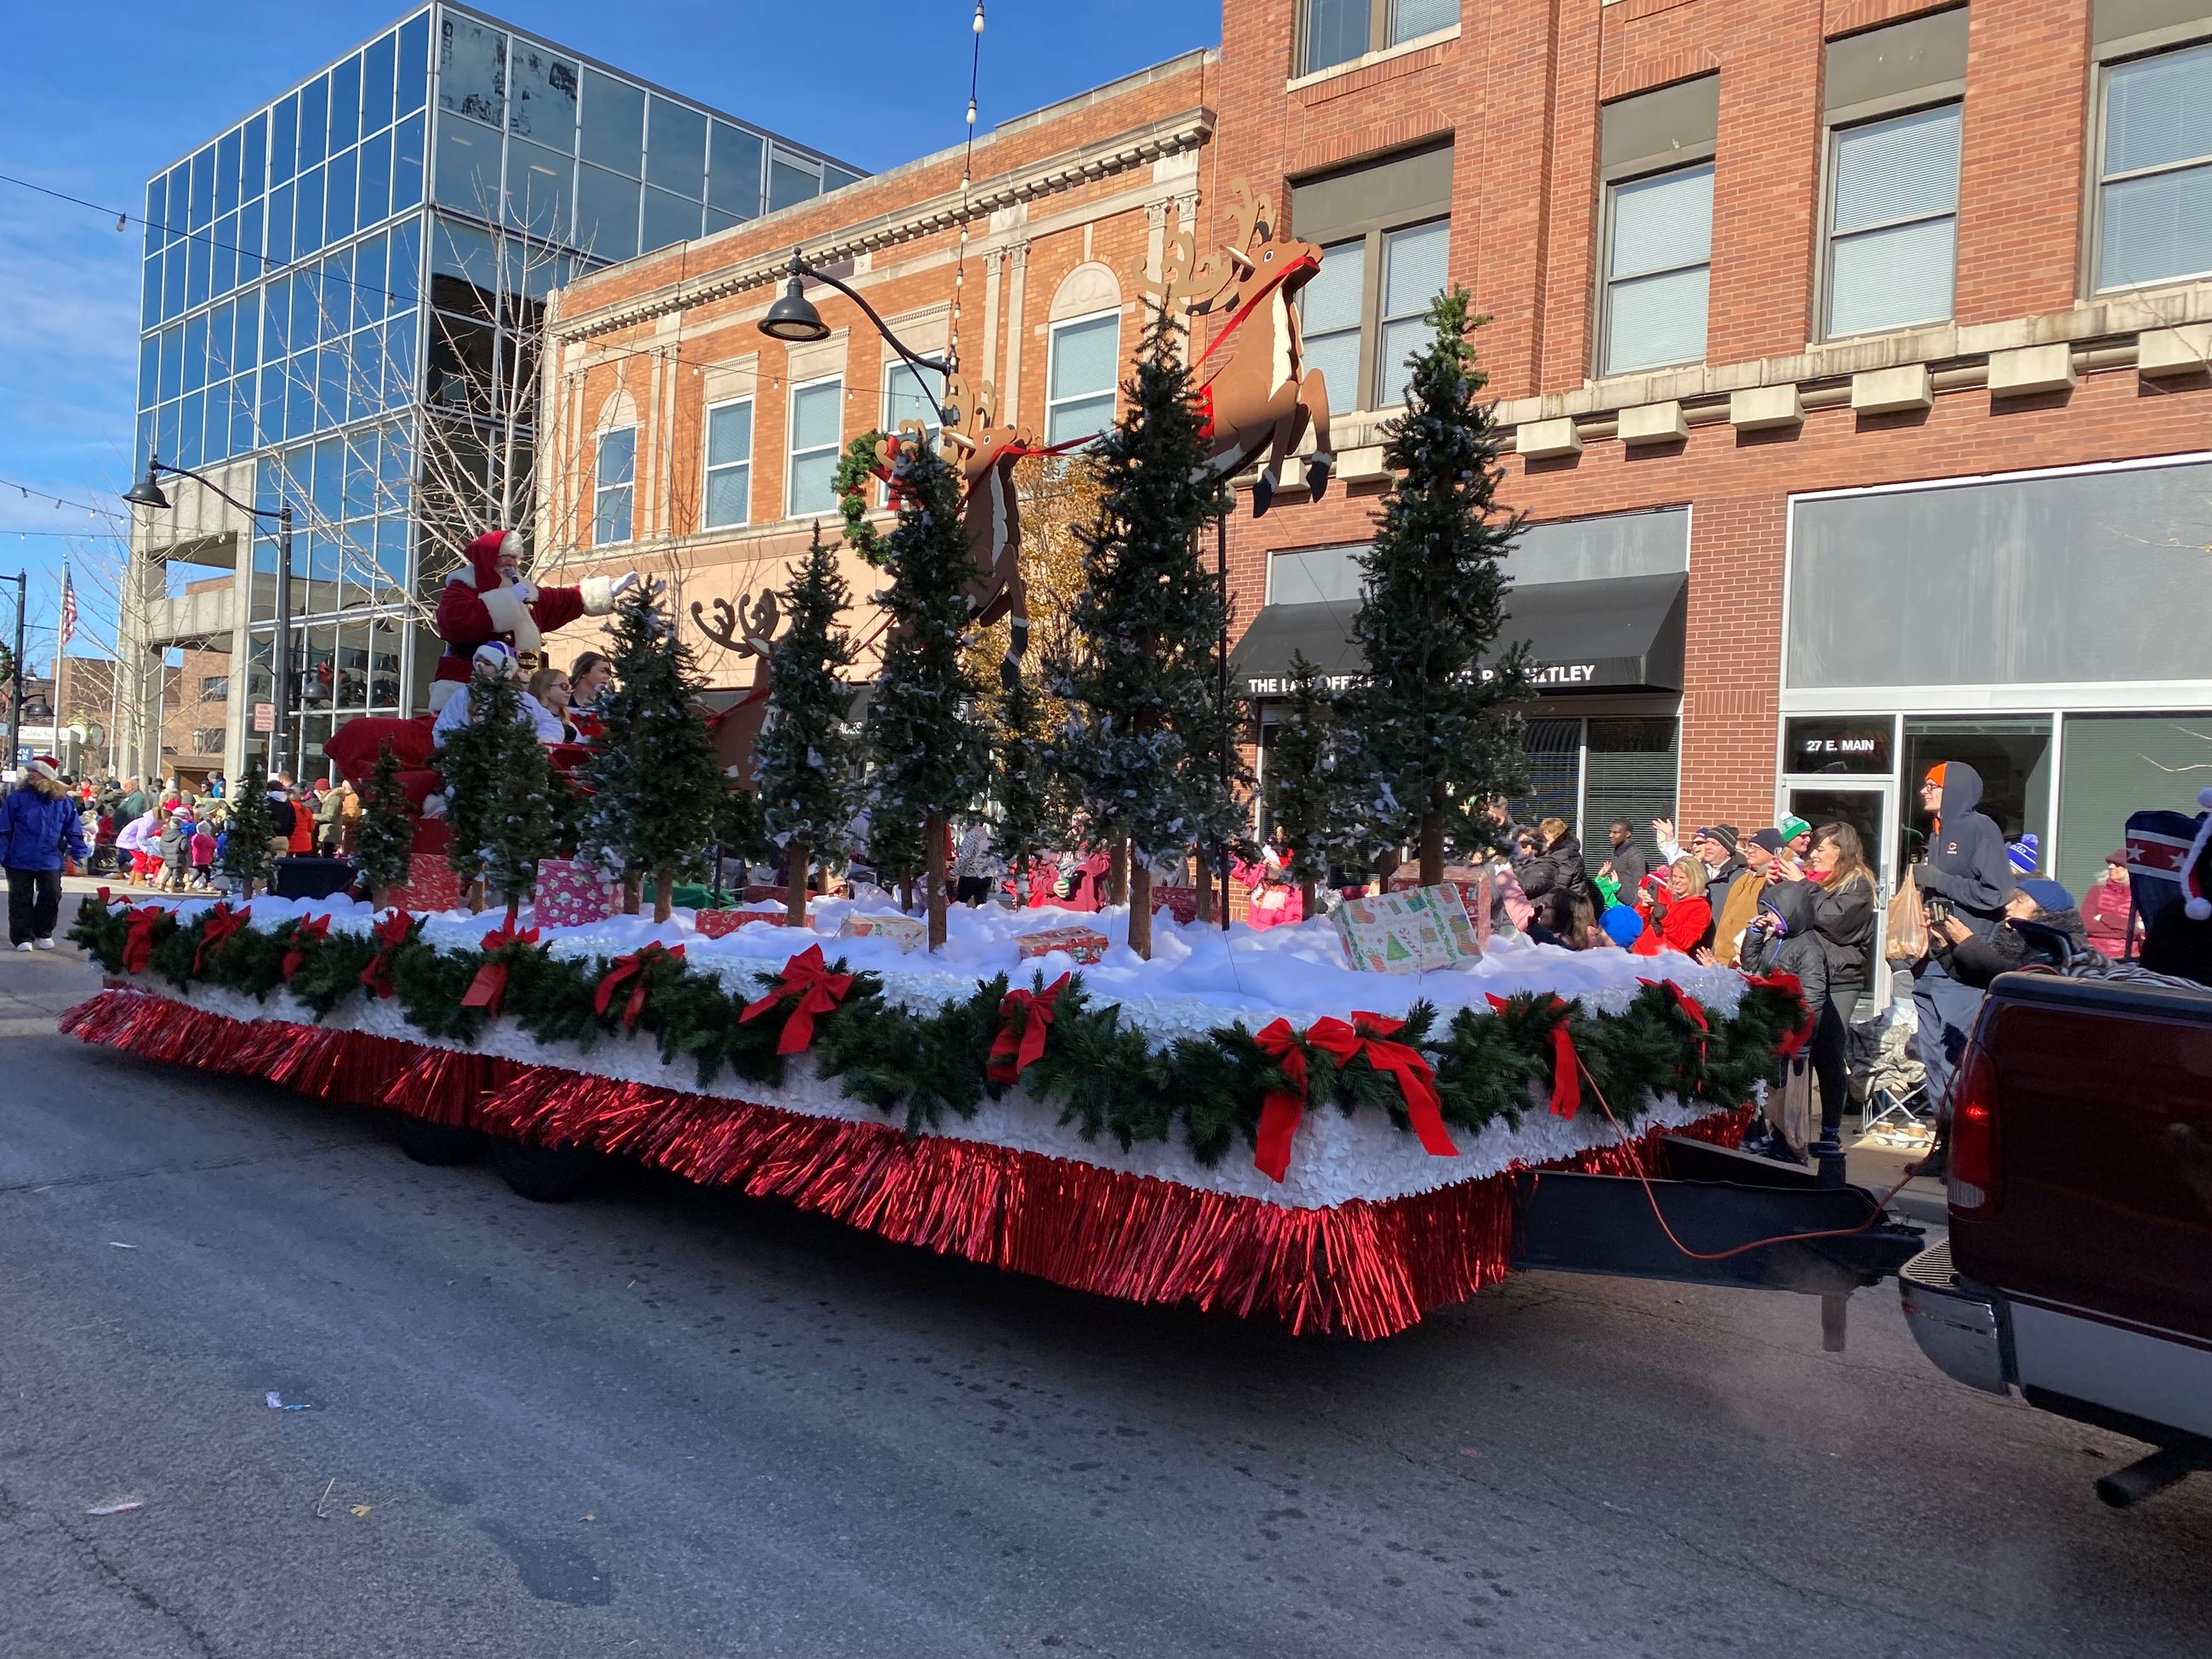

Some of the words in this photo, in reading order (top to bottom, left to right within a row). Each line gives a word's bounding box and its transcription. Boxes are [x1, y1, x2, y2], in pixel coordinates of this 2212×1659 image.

[1248, 677, 1278, 693] THE
[1505, 664, 1595, 684] HITLEY
[43, 730, 68, 739] Sqre
[1806, 739, 1823, 751] 27
[1826, 739, 1839, 751] E.
[1842, 739, 1875, 751] MAIN
